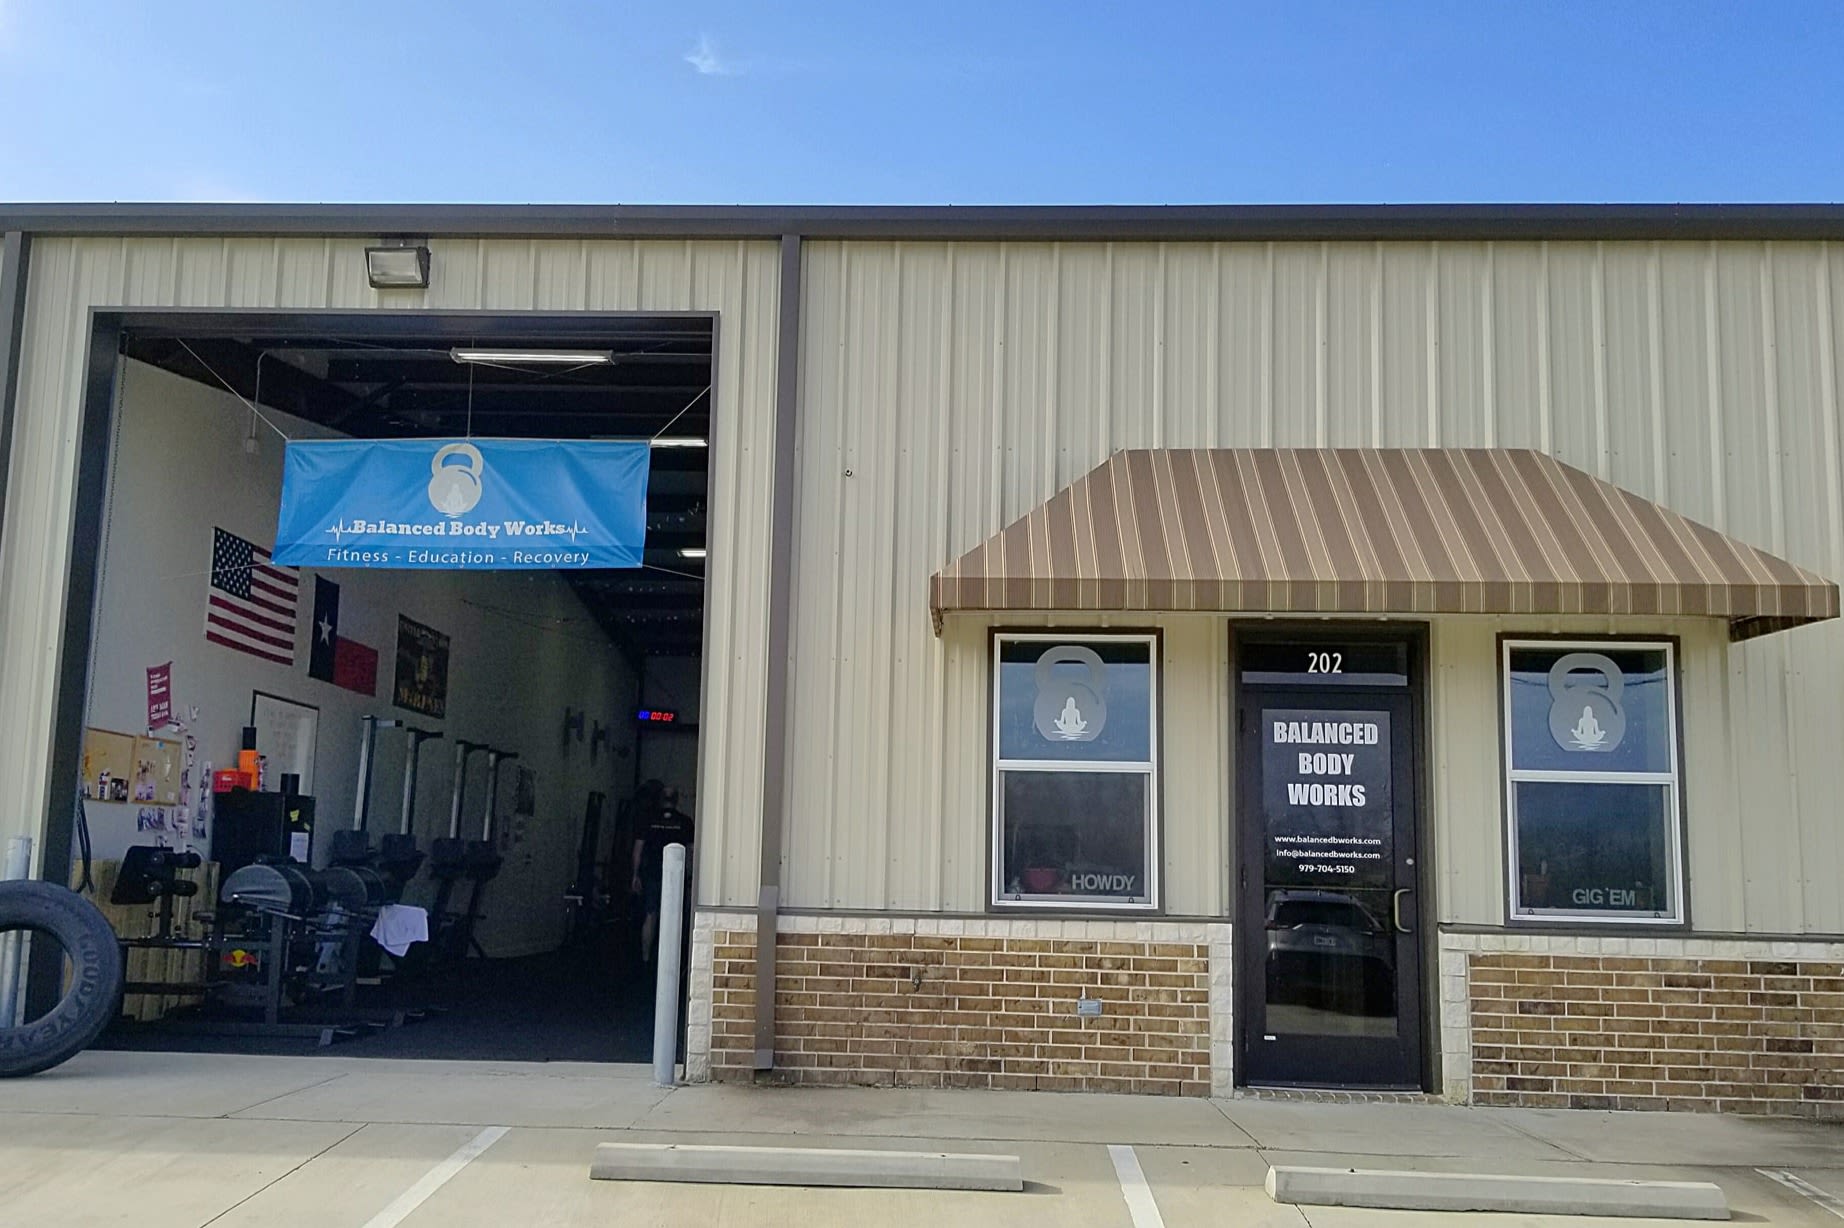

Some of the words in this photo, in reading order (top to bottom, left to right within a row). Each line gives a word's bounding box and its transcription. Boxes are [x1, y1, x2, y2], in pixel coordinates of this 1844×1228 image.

[352, 520, 446, 536] Balanced
[449, 521, 500, 539] Body
[504, 520, 565, 535] Works
[327, 548, 389, 562] Fitness
[408, 550, 494, 563] Education
[513, 551, 589, 566] Recovery
[1307, 652, 1342, 673] 202
[1273, 721, 1379, 745] BALANCED
[1298, 753, 1355, 775] BODY
[1287, 783, 1366, 807] WORKS
[1274, 834, 1382, 845] www.balancedbworks.com
[1298, 864, 1355, 874] 979-704-5150
[1071, 874, 1135, 891] HOWDY
[1572, 888, 1604, 905] GIG
